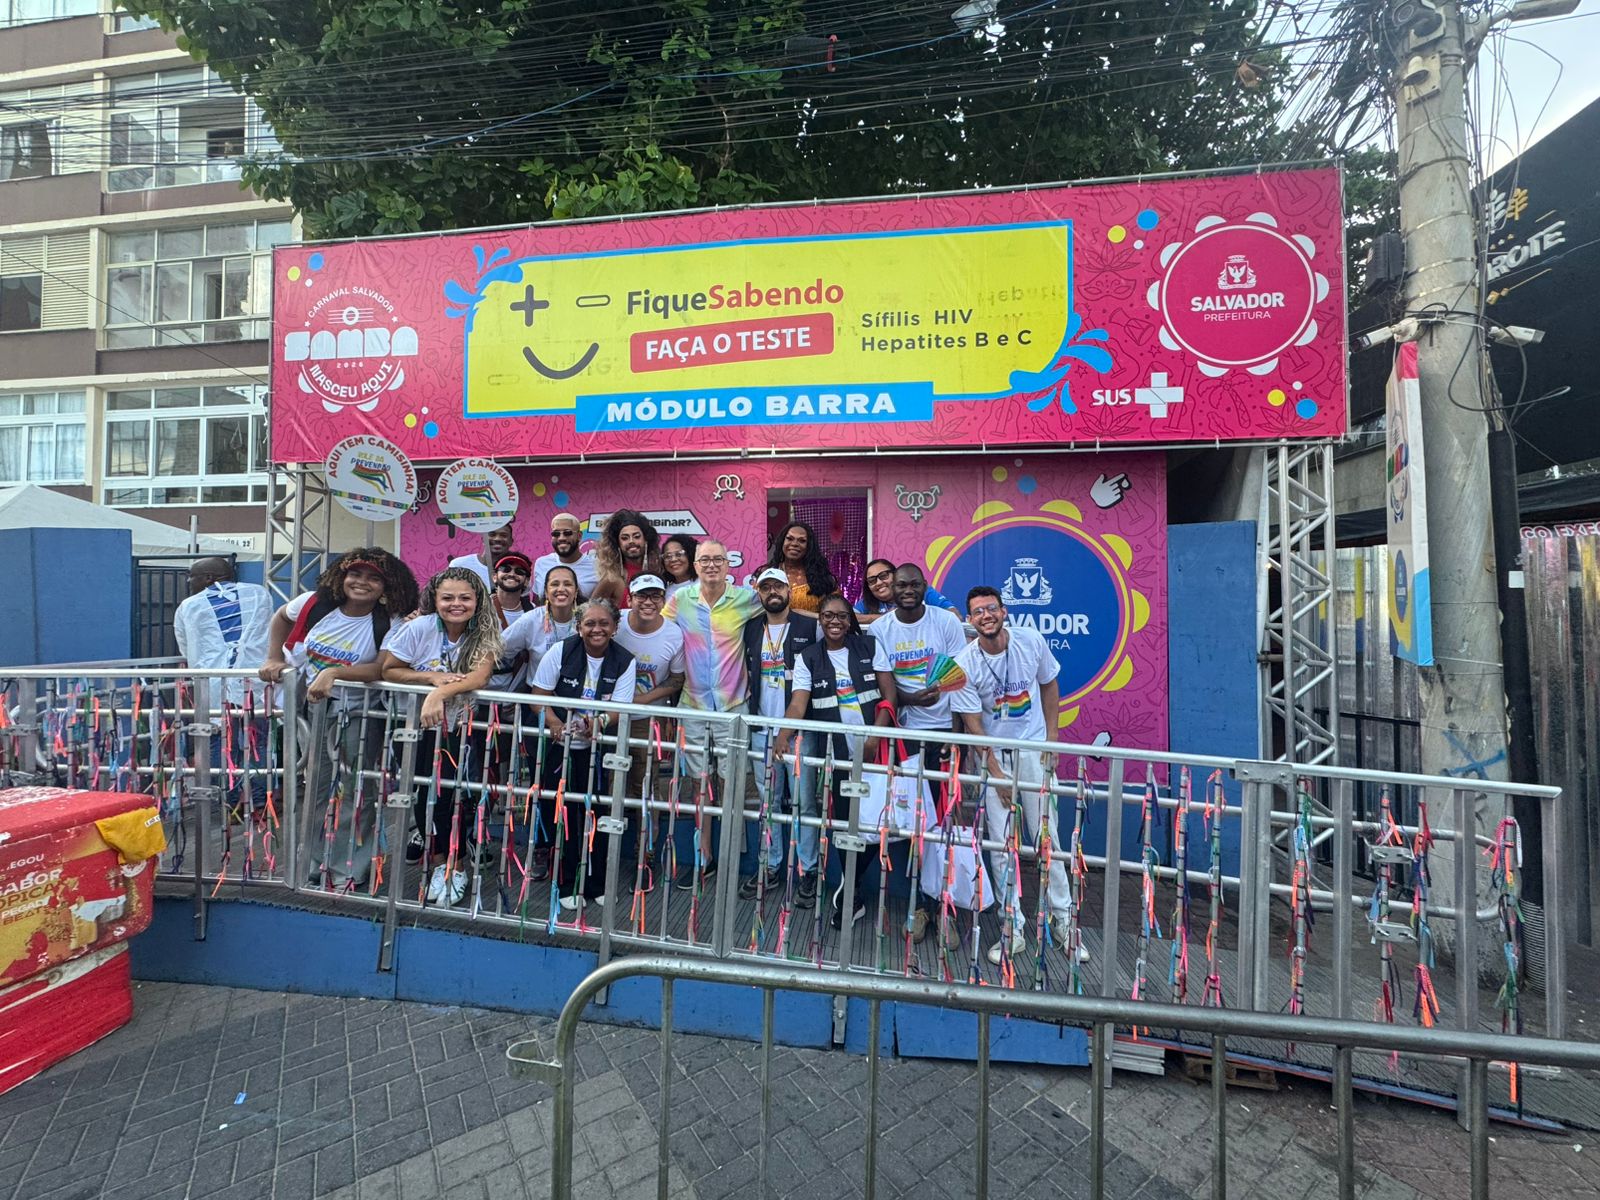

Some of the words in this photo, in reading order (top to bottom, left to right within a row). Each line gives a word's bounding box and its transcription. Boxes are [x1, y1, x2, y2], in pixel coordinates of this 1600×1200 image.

[307, 287, 350, 318] CARNAVAL
[352, 286, 395, 314] SALVADOR
[627, 278, 844, 318] FiqueSabendo
[1190, 291, 1285, 312] SALVADOR
[861, 309, 920, 328] Sífilis
[934, 308, 973, 325] HIV
[1203, 310, 1271, 322] PREFEITURA
[645, 335, 706, 363] FAÇA
[712, 333, 731, 354] O
[736, 326, 812, 352] TESTE
[861, 330, 967, 353] Hepatites
[975, 331, 988, 347] B
[997, 333, 1009, 346] e
[1017, 329, 1032, 346] C
[309, 363, 358, 398] NASCEU
[361, 360, 393, 395] AQUI
[607, 393, 752, 423] MÓDULO
[765, 392, 896, 417] BARRA
[1092, 388, 1132, 406] SUS
[327, 449, 344, 479] AQUI
[339, 437, 366, 452] TEM
[367, 437, 415, 495] CAMISINHA!
[439, 477, 451, 504] AQUI
[446, 461, 468, 477] TEM
[468, 458, 516, 502] CAMISINHA!
[1003, 613, 1090, 635] VADOR
[6, 853, 45, 870] EGOU
[0, 868, 62, 896] ABOR
